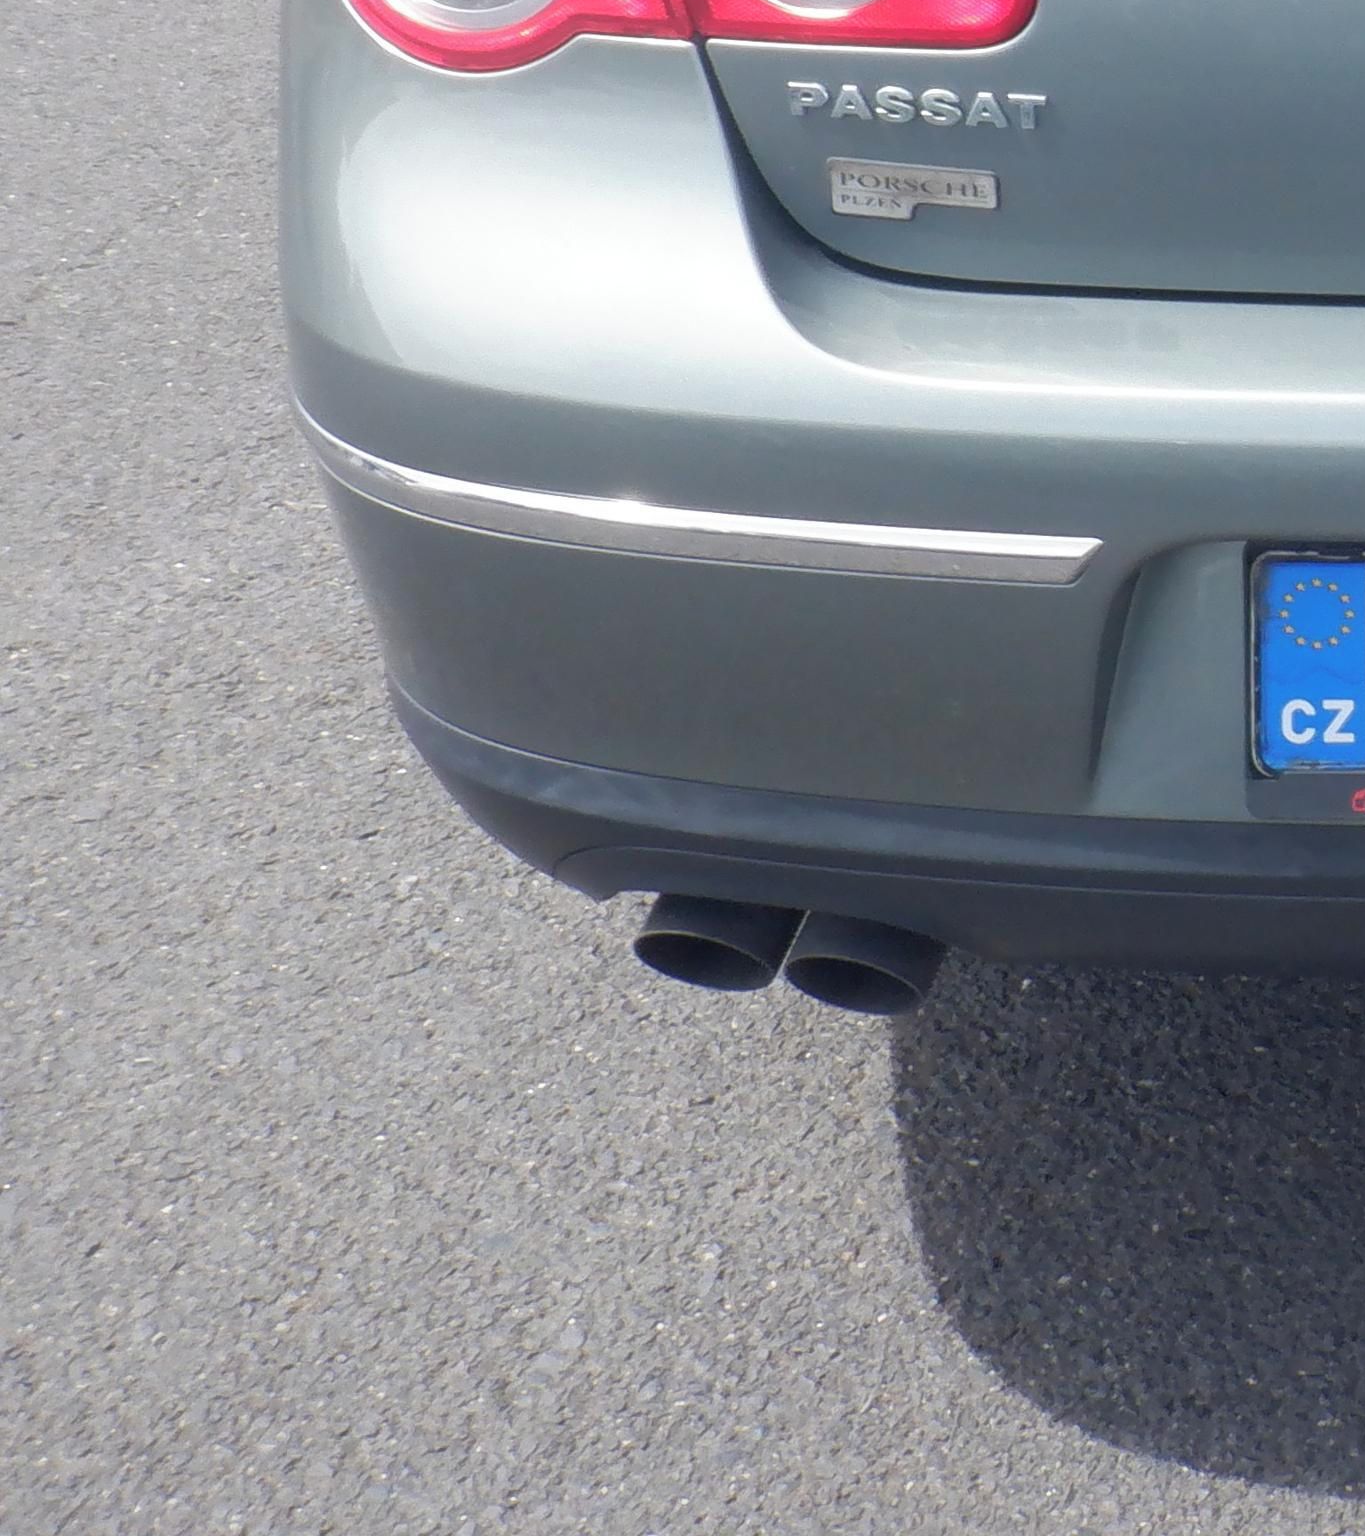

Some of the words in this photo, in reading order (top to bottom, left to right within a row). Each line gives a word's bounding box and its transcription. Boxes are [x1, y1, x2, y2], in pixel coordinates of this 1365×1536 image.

[786, 80, 1047, 129] PASSAT
[839, 171, 988, 199] PORSCHE
[1281, 699, 1355, 744] CZ
